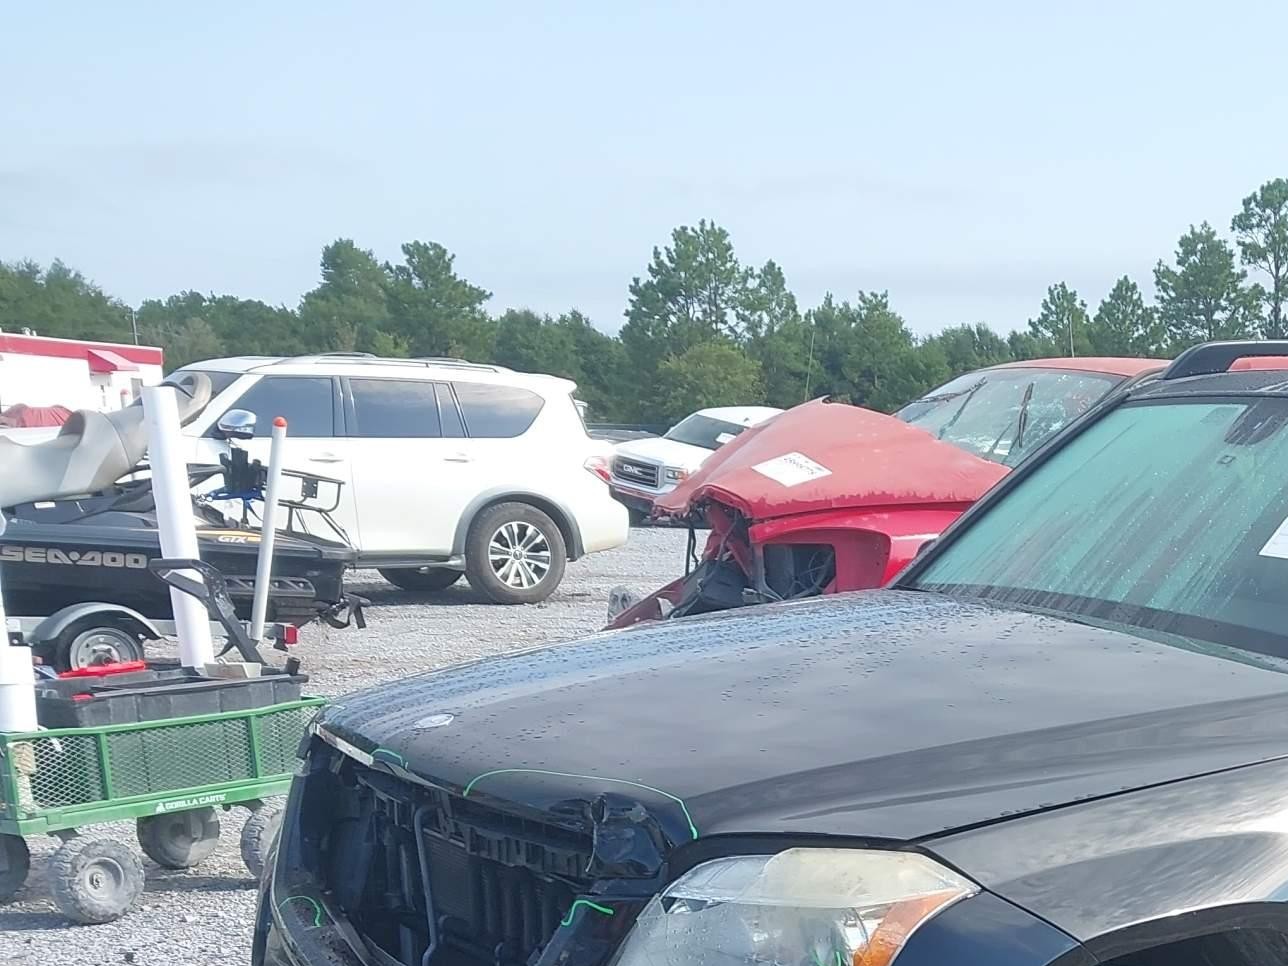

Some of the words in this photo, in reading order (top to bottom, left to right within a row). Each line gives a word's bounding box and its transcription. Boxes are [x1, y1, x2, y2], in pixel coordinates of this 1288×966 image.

[623, 464, 642, 475] GMC
[218, 535, 247, 544] GTX
[165, 798, 199, 810] GORILLA
[199, 794, 226, 804] CARTS
